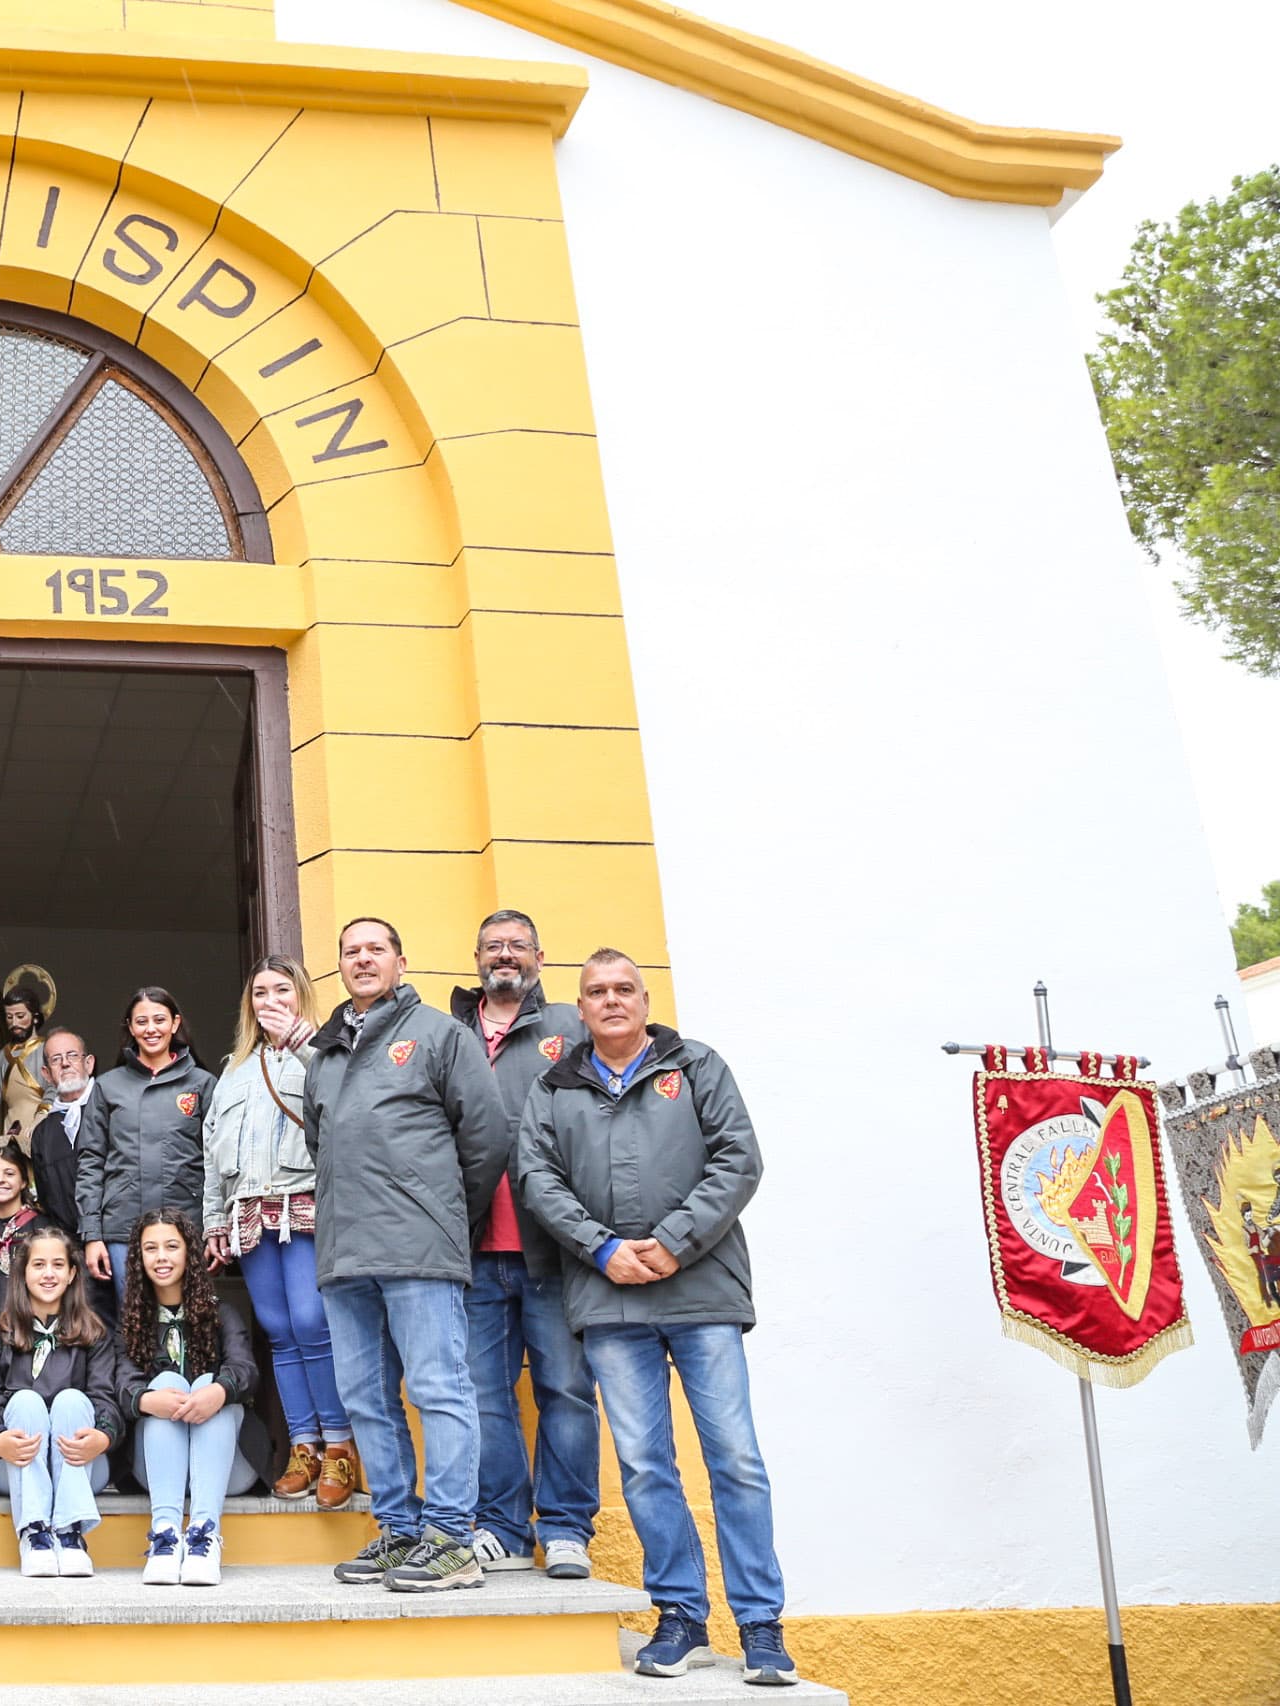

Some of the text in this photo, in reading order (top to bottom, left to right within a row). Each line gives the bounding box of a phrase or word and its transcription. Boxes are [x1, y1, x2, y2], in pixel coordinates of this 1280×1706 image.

[45, 568, 169, 617] 1952
[1007, 1120, 1096, 1254] JUNTA CENTRAL FALLAS
